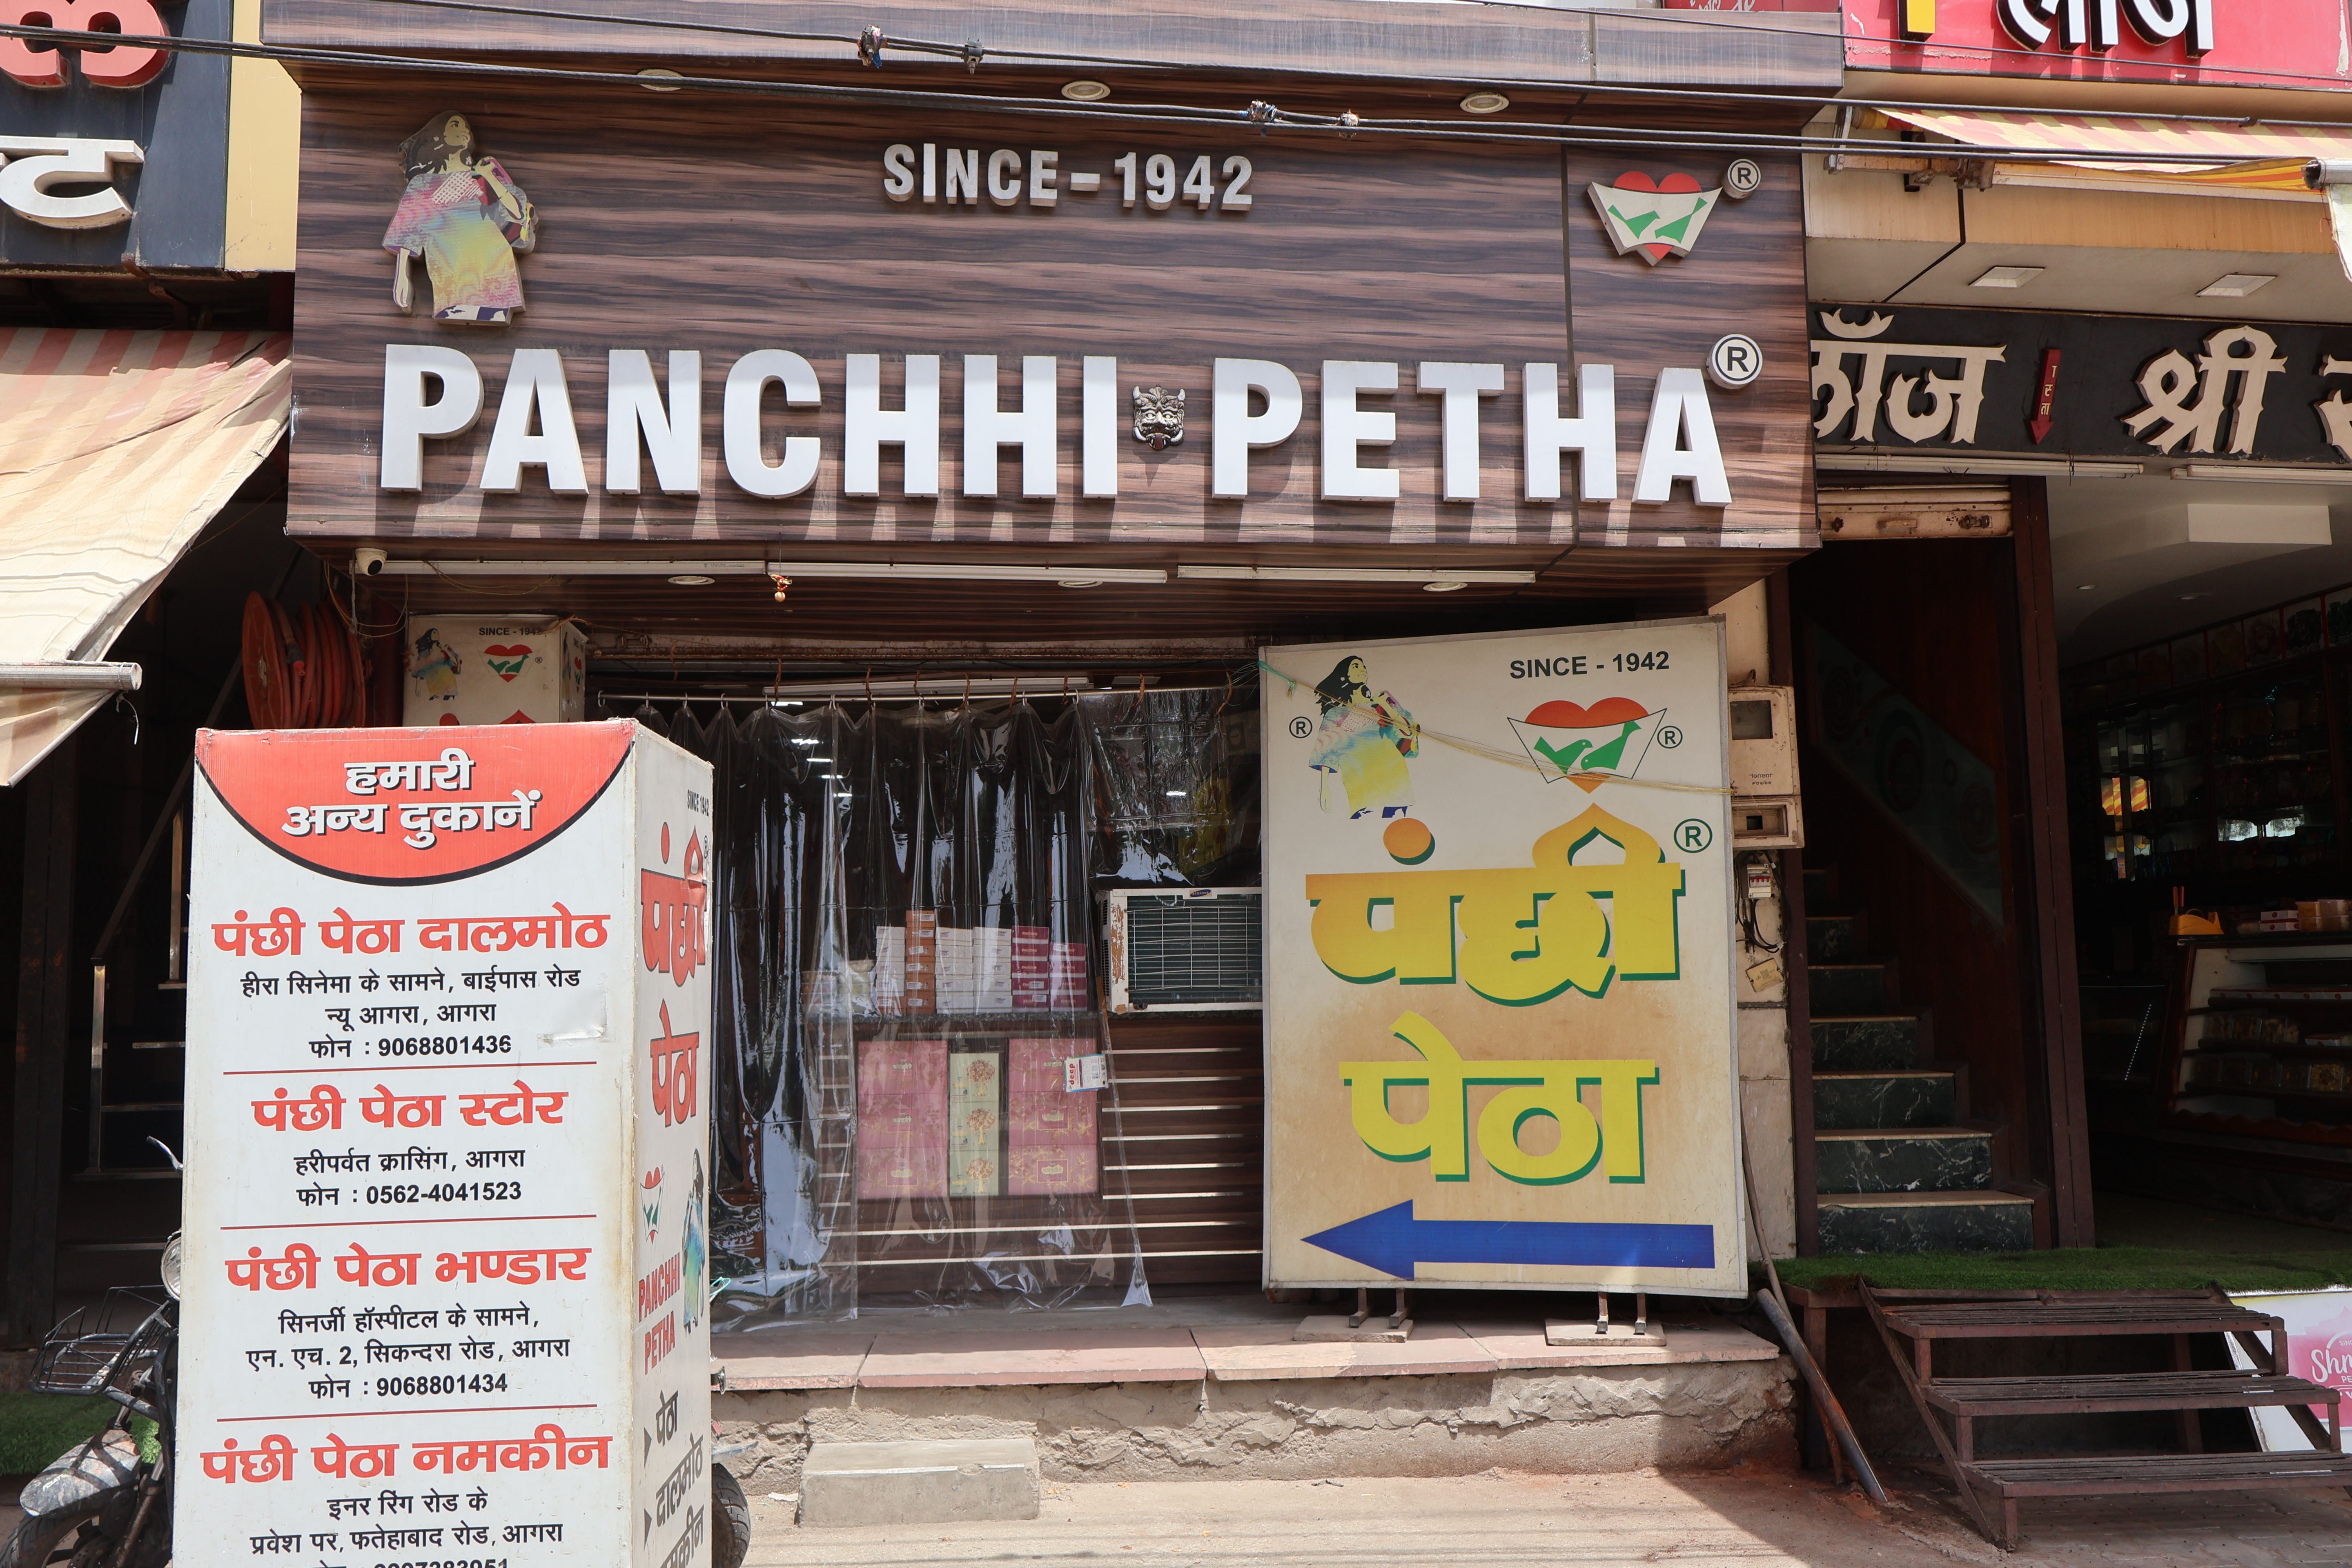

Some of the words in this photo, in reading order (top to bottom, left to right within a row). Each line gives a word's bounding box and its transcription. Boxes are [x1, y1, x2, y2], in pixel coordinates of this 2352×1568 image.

[2121, 325, 2288, 454] श्री
[380, 344, 1118, 499] PANCHHI
[1212, 356, 1733, 507] PETHA
[479, 627, 510, 635] SINCE
[519, 627, 542, 635] 1942
[1510, 655, 1588, 679] SINCE
[1612, 651, 1670, 673] 1942
[344, 747, 475, 795] हमारी
[282, 803, 390, 837] अन्य
[399, 788, 542, 850] दुकानें
[687, 789, 699, 813] SINCE
[699, 795, 709, 817] 1942
[641, 822, 707, 987] पंछी
[1305, 802, 1686, 1007] पंछी
[212, 907, 306, 957] पंछी
[318, 907, 405, 954] पेठा
[417, 902, 610, 953] दालमोठ
[240, 971, 279, 998] हीरा
[286, 970, 351, 995] सिनेमा
[359, 968, 380, 992] के
[461, 964, 537, 993] बाईपास
[544, 963, 581, 987] रोड
[325, 1008, 355, 1032] न्यू
[437, 1004, 497, 1022] आगरा
[309, 1033, 352, 1058] फोन
[379, 1035, 511, 1056] 9068801436
[650, 998, 699, 1128] पेठा
[252, 1085, 346, 1131] पंछी
[359, 1084, 446, 1128] पेठा
[459, 1080, 568, 1126] स्टोर
[1339, 1010, 1660, 1186] पेठा
[466, 1150, 526, 1168] आगरा
[296, 1182, 339, 1206] फोन
[366, 1181, 521, 1204] 0562-4041523
[225, 1243, 321, 1291] पंछी
[334, 1243, 421, 1287] पेठा
[436, 1248, 592, 1285] भण्डार
[638, 1252, 681, 1324] PANCHHI
[278, 1306, 345, 1334] सिनर्जी
[445, 1303, 467, 1327] के
[644, 1309, 676, 1376] PETHA
[364, 1339, 452, 1363] सिकन्दरा
[512, 1339, 570, 1358] आगरा
[308, 1373, 351, 1399] फोन
[377, 1373, 508, 1396] 9068801434
[655, 1389, 679, 1448] पेठा
[200, 1434, 298, 1483] पंछी
[311, 1433, 399, 1479] पेठा
[412, 1424, 613, 1474] नमकीन
[326, 1498, 371, 1521] इनर
[377, 1490, 414, 1515] रिंग
[421, 1488, 459, 1513] रोड
[466, 1486, 488, 1511] के
[655, 1431, 704, 1528] दालमोठ
[249, 1528, 302, 1555] प्रवेश
[349, 1523, 444, 1550] फतेहाबाद
[502, 1524, 563, 1543] आगरा
